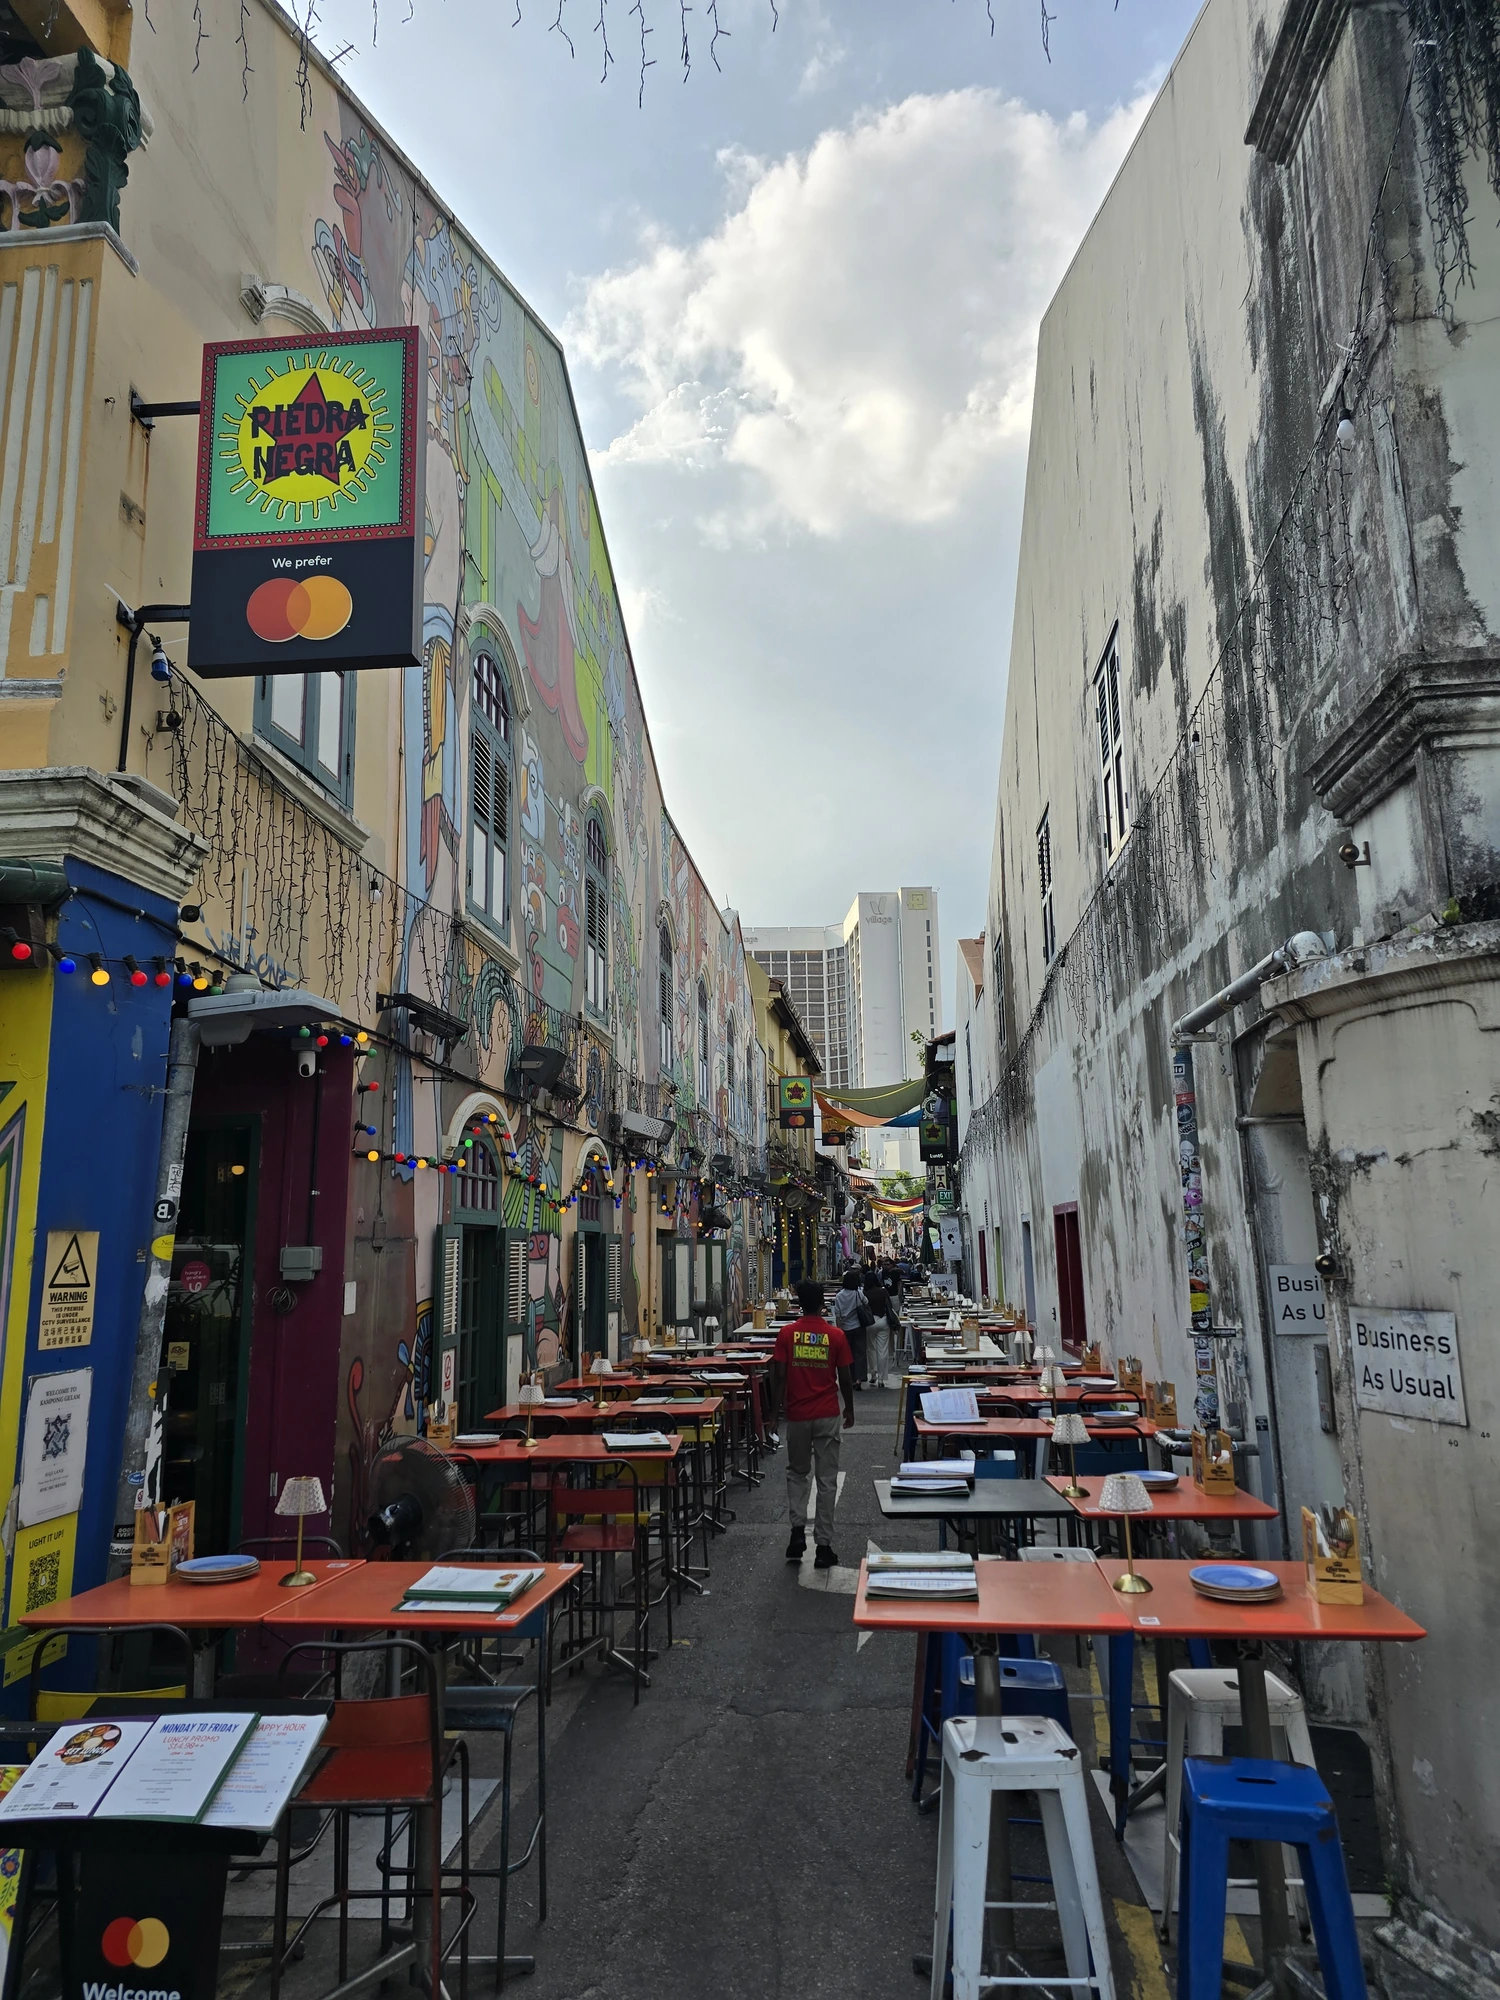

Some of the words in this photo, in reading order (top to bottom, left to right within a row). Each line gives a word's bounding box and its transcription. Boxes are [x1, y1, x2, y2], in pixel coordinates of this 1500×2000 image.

[252, 399, 367, 438] PIEDRA
[253, 440, 356, 479] NEGRA
[272, 558, 292, 568] We
[295, 556, 332, 569] prefer
[865, 916, 893, 926] village
[1277, 1275, 1321, 1292] Busi
[49, 1291, 88, 1302] WARNING
[1282, 1304, 1306, 1320] As
[56, 1317, 91, 1325] SURVEILLANCE
[793, 1331, 830, 1346] PIEDRA
[1356, 1323, 1451, 1354] Business
[795, 1345, 827, 1360] NEGRA
[1362, 1365, 1384, 1390] As
[1389, 1368, 1455, 1400] Usual
[45, 1387, 69, 1397] WELCOME
[28, 1536, 46, 1549] LIGHT
[47, 1532, 53, 1543] IT
[53, 1529, 65, 1541] UP!
[1325, 1566, 1350, 1574] Corona
[160, 1723, 197, 1733] MONDAY
[197, 1723, 207, 1732] TO
[207, 1723, 239, 1733] FRIDAY
[162, 1736, 190, 1744] LUNCH
[191, 1735, 220, 1743] PROMO
[82, 1981, 182, 2000] Welcome
